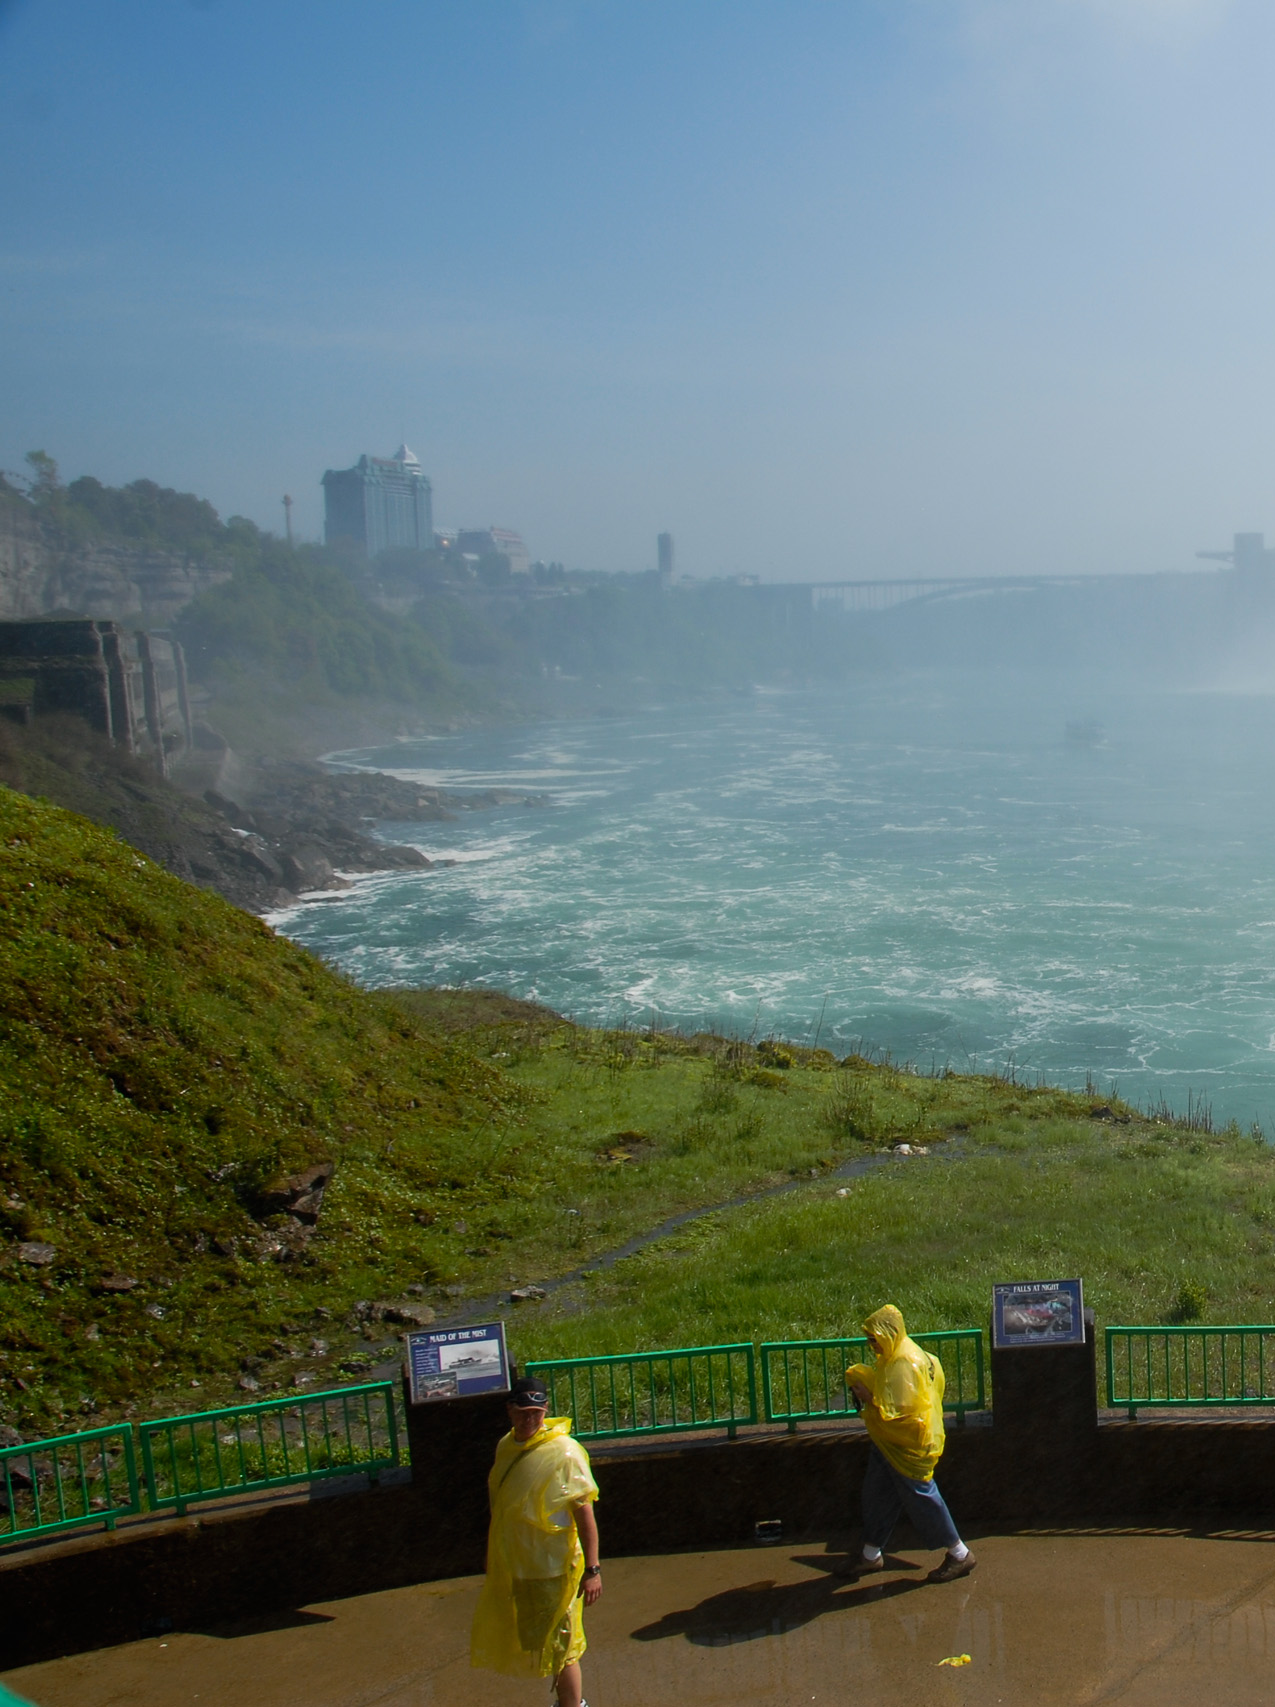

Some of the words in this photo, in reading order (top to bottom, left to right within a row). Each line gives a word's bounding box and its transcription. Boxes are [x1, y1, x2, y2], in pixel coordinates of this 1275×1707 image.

[1013, 1284, 1031, 1293] FALLS
[1042, 1283, 1060, 1291] NIGHT
[430, 1334, 446, 1343] MAID
[448, 1332, 456, 1341] OF
[458, 1331, 471, 1339] THE
[472, 1329, 488, 1338] MIST
